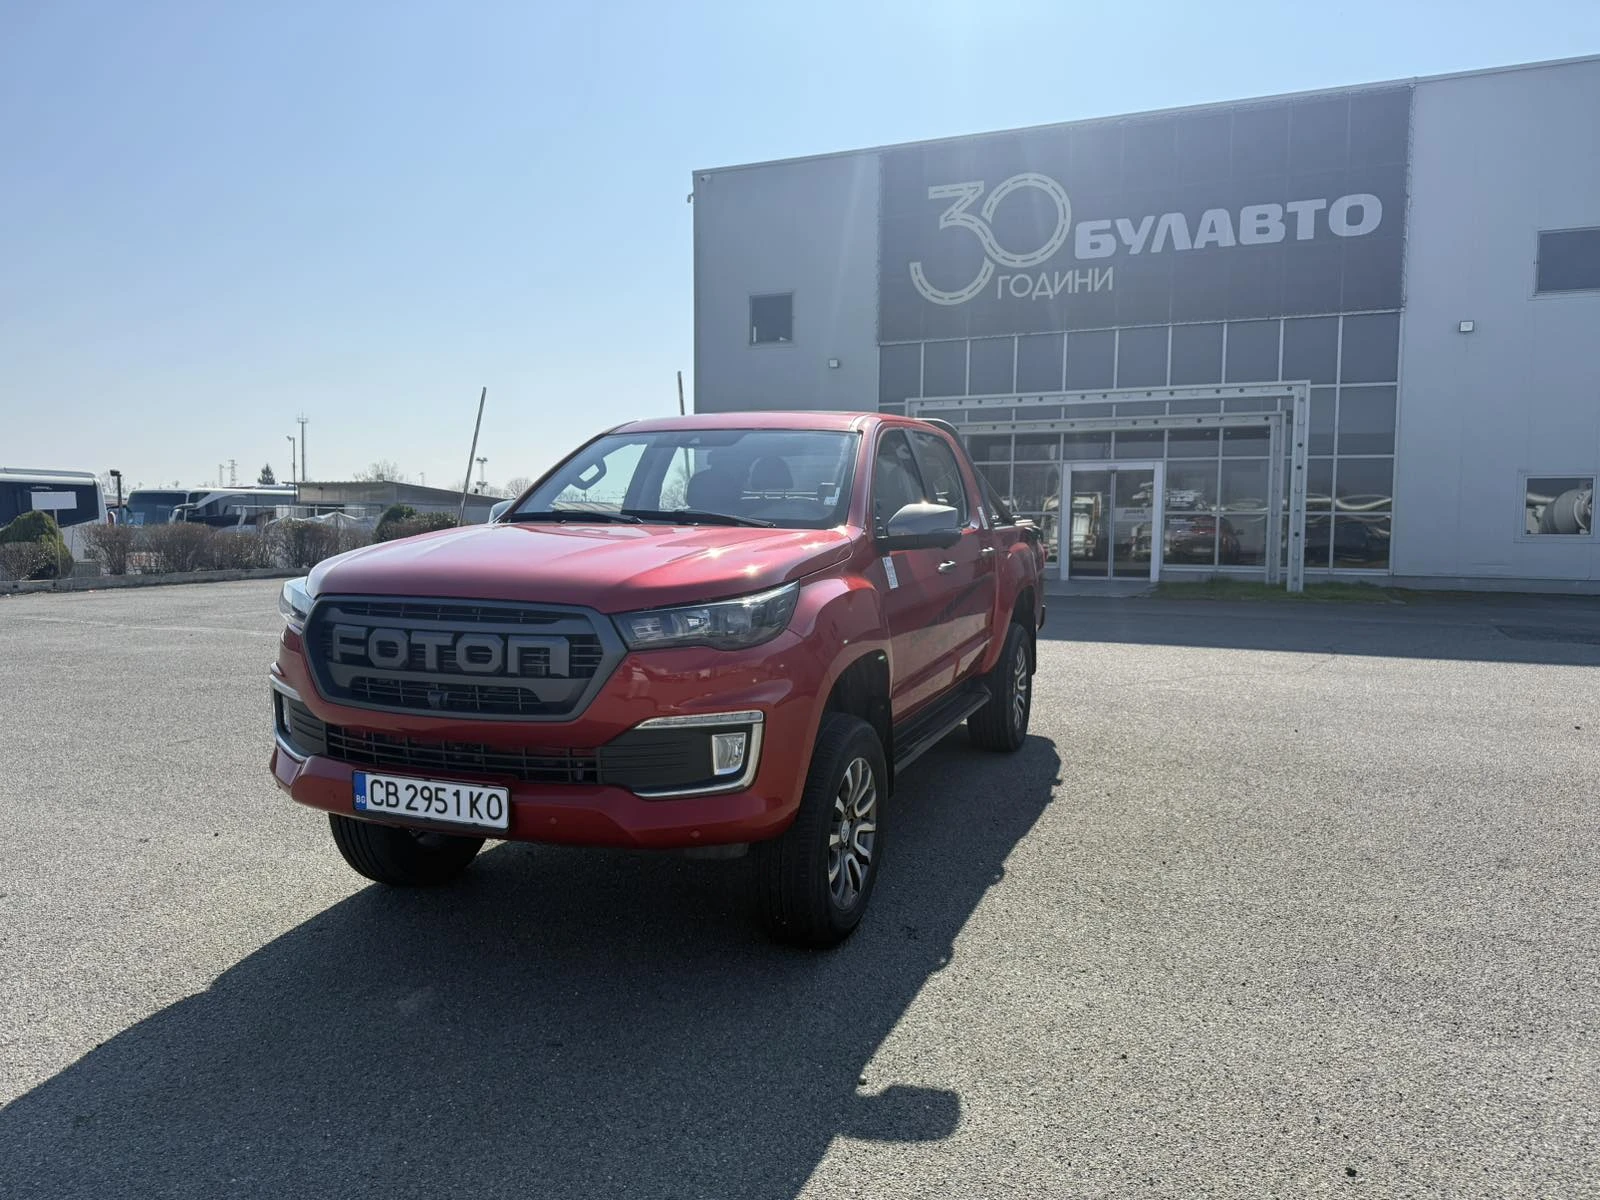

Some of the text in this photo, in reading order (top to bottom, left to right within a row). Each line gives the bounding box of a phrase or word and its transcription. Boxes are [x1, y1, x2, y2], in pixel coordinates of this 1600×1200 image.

[909, 172, 1071, 305] 30
[1074, 193, 1383, 260] БУЛАВТО
[997, 266, 1113, 300] ГОДИНИ
[332, 624, 570, 677] FOTON
